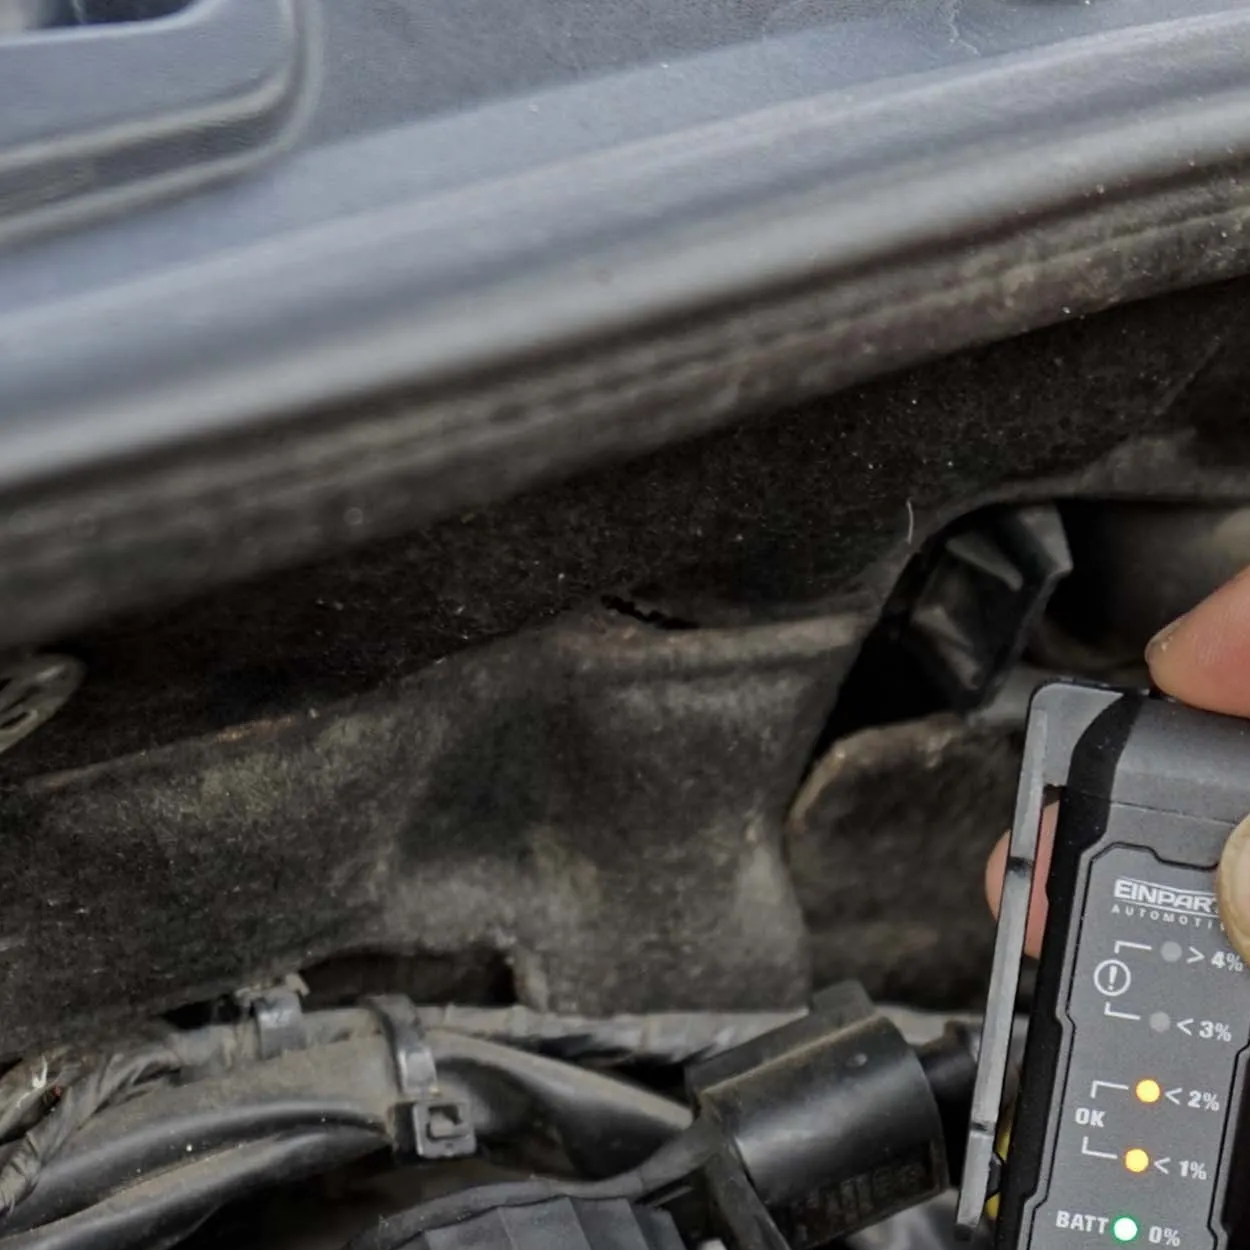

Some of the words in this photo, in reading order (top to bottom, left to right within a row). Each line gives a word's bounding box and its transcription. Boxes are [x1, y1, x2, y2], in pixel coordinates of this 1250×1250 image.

[1186, 946, 1205, 963] >
[1211, 951, 1244, 973] 4%
[1176, 1018, 1194, 1036] <
[1199, 1020, 1232, 1043] 3%
[1164, 1087, 1183, 1105] <
[1187, 1090, 1220, 1112] 2%
[1075, 1108, 1104, 1127] OK
[1153, 1157, 1171, 1175] <
[1179, 1160, 1207, 1180] 1%
[1055, 1210, 1109, 1235] BATT
[1149, 1226, 1181, 1247] 0%
